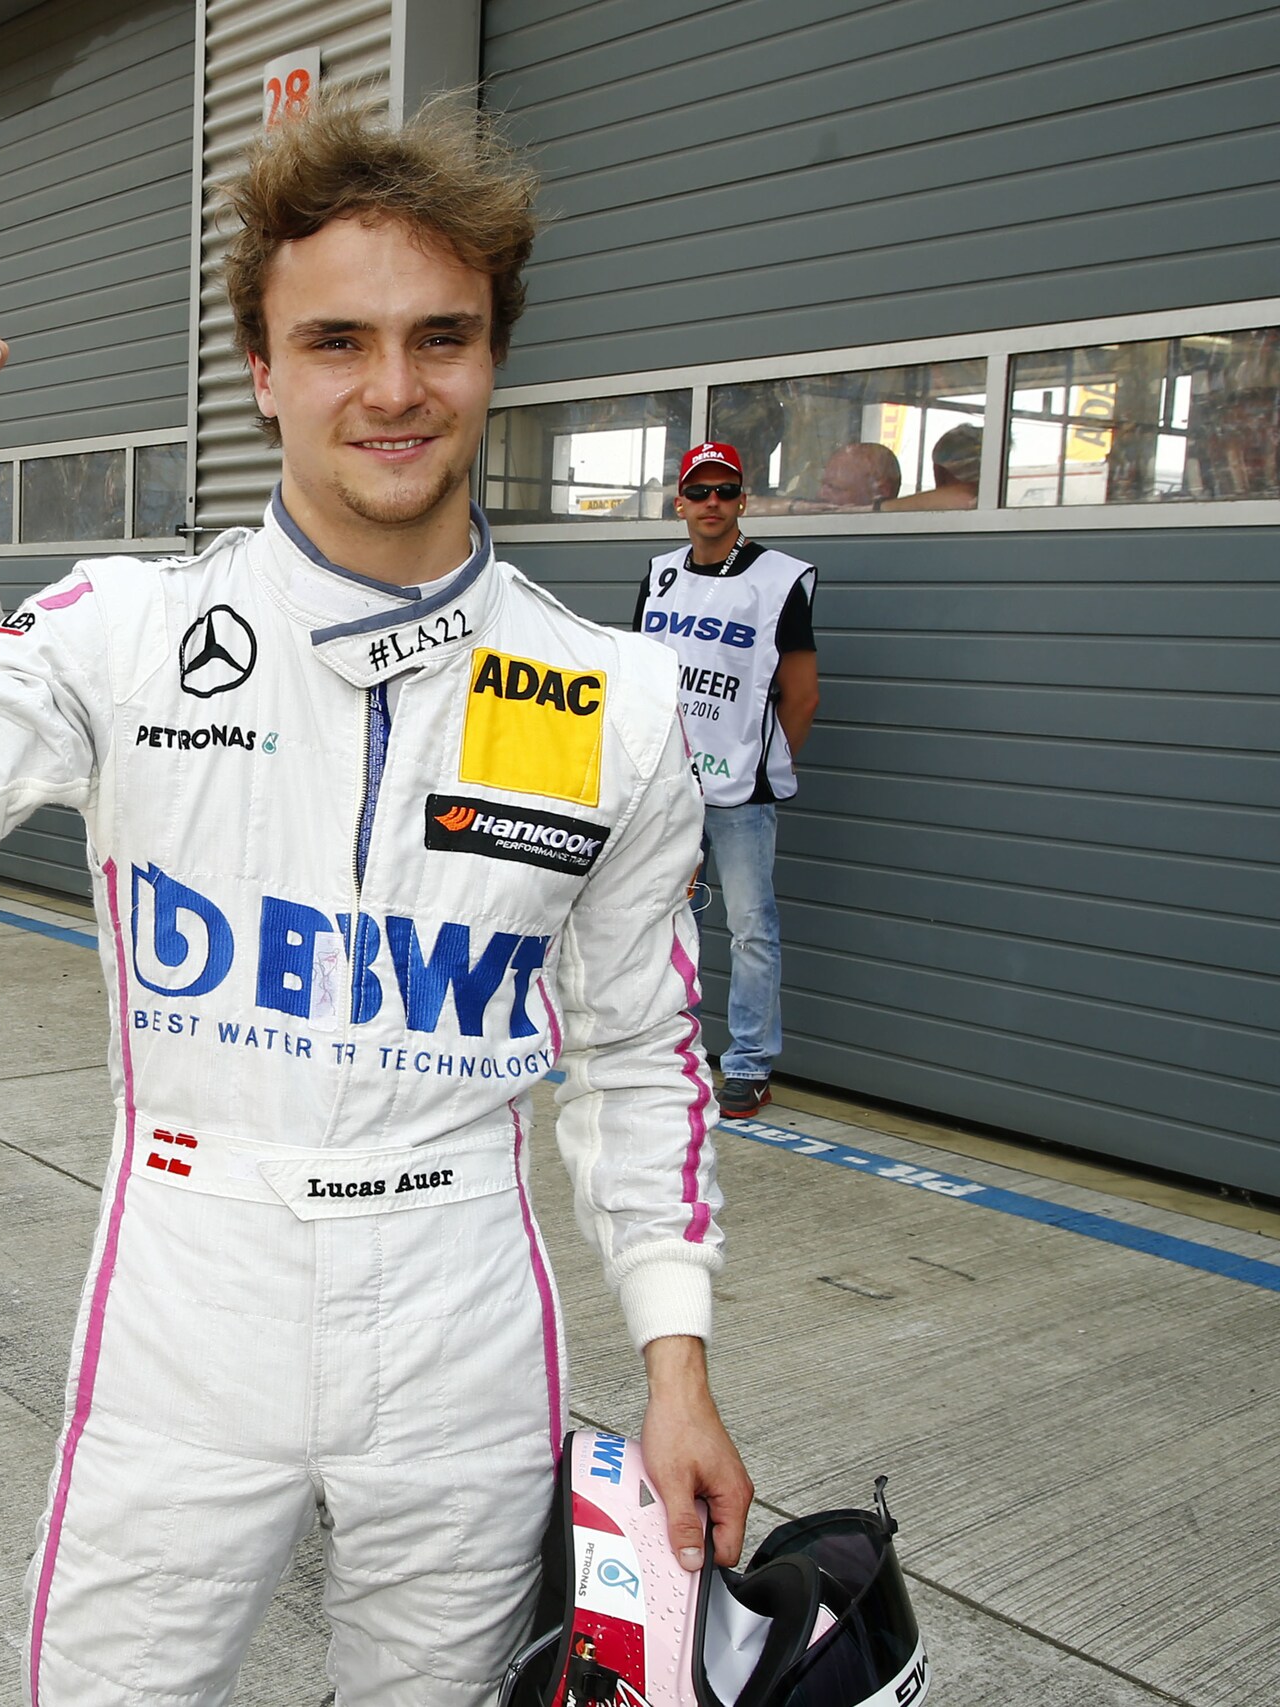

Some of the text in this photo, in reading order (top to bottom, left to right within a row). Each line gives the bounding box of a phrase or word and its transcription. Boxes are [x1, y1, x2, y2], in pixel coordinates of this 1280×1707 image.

[692, 450, 725, 464] DEKRA
[658, 567, 677, 599] 9
[369, 608, 474, 671] #LA22
[474, 654, 601, 716] ADAC
[678, 664, 740, 702] NEER
[691, 700, 721, 721] 2016
[135, 724, 257, 751] PETRONAS
[133, 1009, 200, 1037] BEST
[219, 1022, 312, 1059] WATER
[380, 1047, 554, 1080] TECHNOLOGY
[307, 1167, 454, 1199] Lucas Auer
[590, 1431, 626, 1485] BWT
[578, 1542, 595, 1598] PETRONAS
